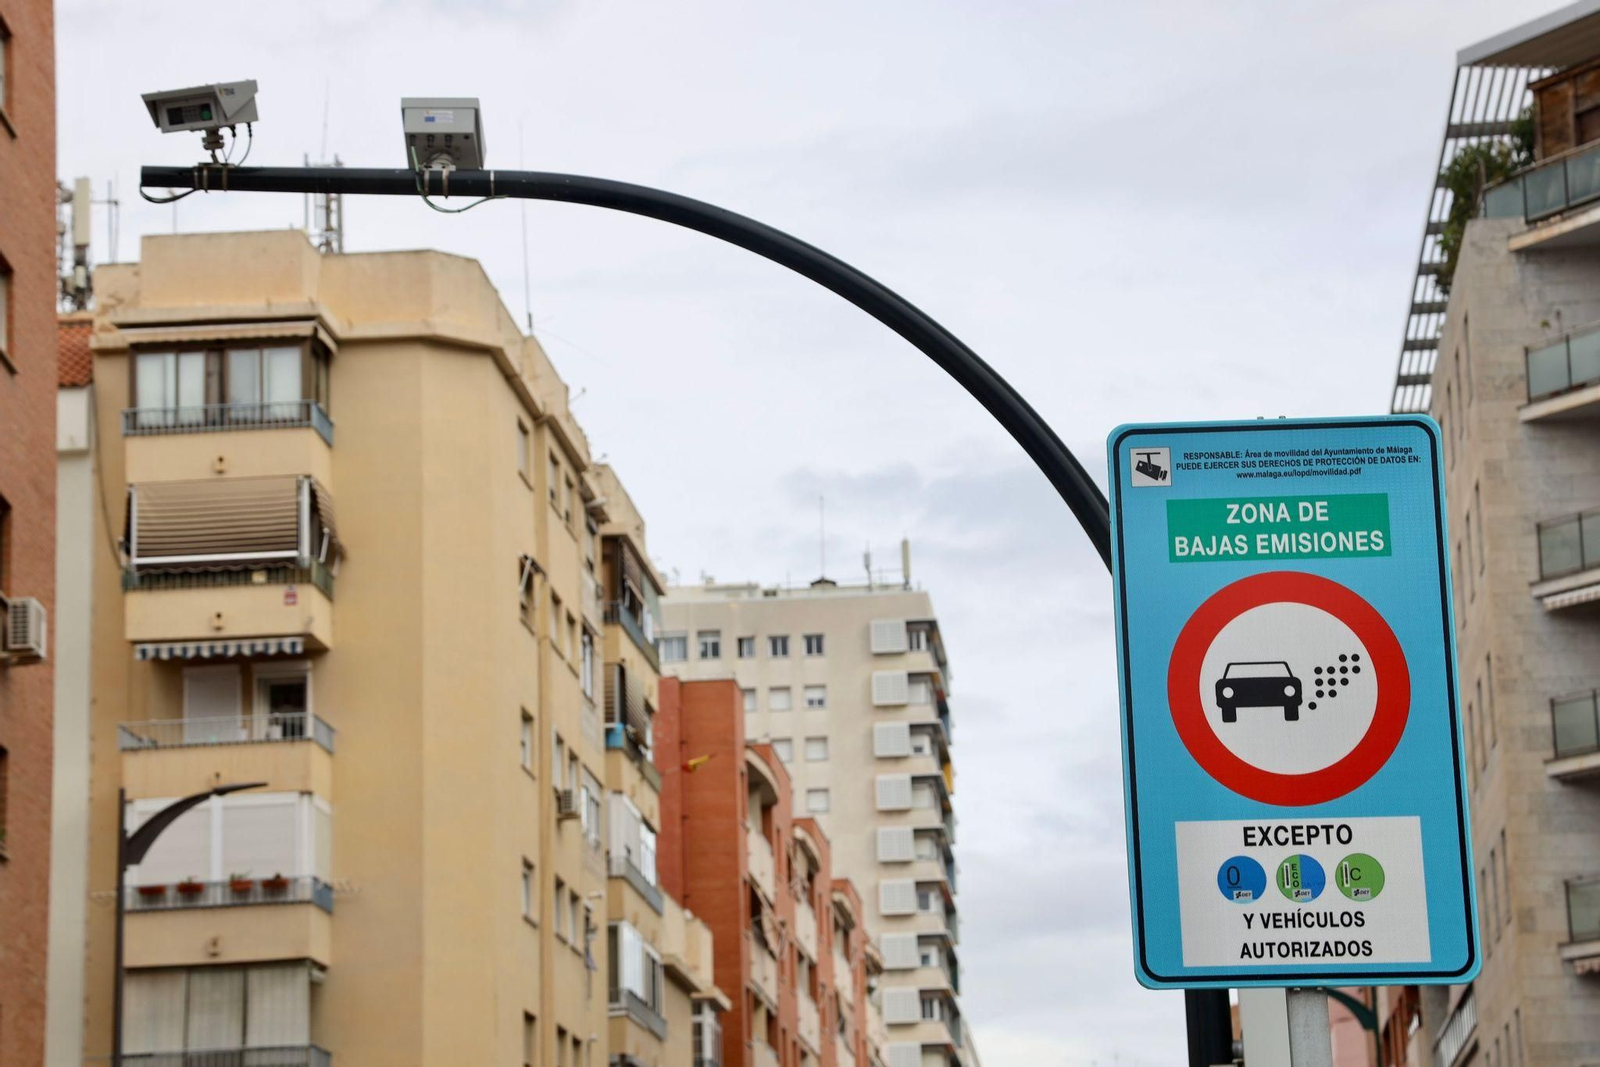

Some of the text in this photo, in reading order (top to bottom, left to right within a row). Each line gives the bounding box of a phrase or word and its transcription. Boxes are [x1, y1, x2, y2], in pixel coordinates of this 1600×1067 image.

[1176, 462, 1201, 470] PUEDE
[1204, 461, 1239, 469] EJERCER
[1259, 459, 1301, 468] DERECHOS
[1316, 456, 1365, 466] PROTECCIÓN
[1380, 456, 1406, 464] DATOS
[1408, 455, 1421, 463] EN:
[1183, 451, 1243, 460] RESPONSABLE:
[1245, 449, 1261, 458] Área
[1274, 448, 1309, 457] movilidad
[1324, 447, 1374, 457] Ayuntamiento
[1387, 446, 1413, 454] Málaga
[1226, 501, 1329, 524] ZONA DE
[1175, 530, 1385, 556] BAJAS EMISIONES
[1243, 824, 1353, 847] EXCEPTO
[1350, 867, 1361, 881] C
[1243, 908, 1365, 929] Y VEHÍCULOS
[1240, 940, 1373, 959] AUTORIZADOS
